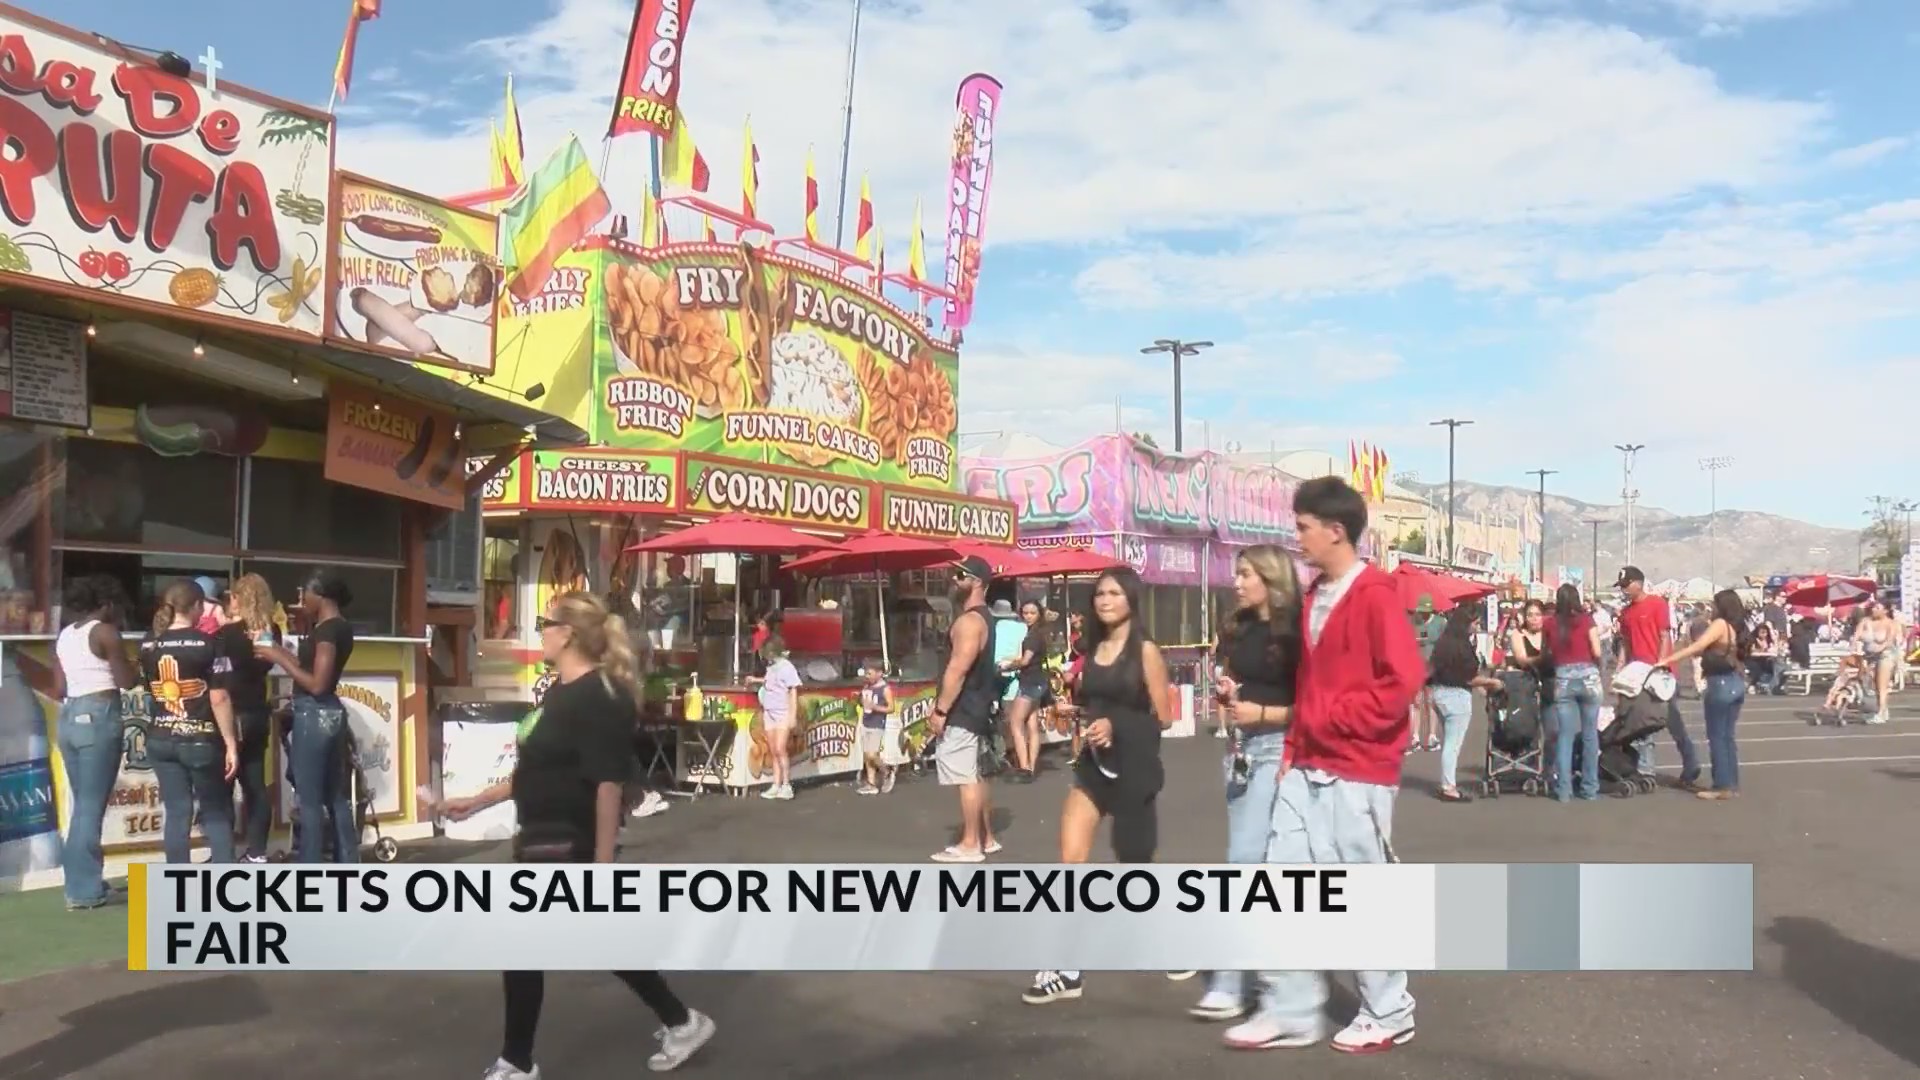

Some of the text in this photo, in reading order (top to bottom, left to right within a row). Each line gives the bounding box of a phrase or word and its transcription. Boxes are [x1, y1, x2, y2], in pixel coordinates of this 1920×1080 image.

[111, 62, 241, 155] De
[619, 96, 674, 130] FRIES
[368, 194, 394, 213] LONG
[395, 199, 421, 218] CORN
[415, 246, 440, 268] FRIED
[441, 246, 460, 262] MAC
[676, 267, 917, 364] FRY FACTORY
[609, 380, 694, 419] RIBBON
[343, 400, 417, 443] FROZEN
[618, 405, 682, 435] FRIES
[727, 414, 880, 464] FUNNEL CAKES
[907, 438, 951, 460] CURLY
[561, 458, 648, 473] CHEESY
[909, 458, 948, 481] FRIES
[539, 470, 669, 503] BACON FRIES
[707, 470, 861, 519] CORN DOGS
[888, 496, 1010, 537] FUNNEL CAKES
[820, 699, 844, 716] FRESH
[807, 723, 855, 746] RIBBON
[813, 741, 849, 760] FRIES
[125, 814, 162, 834] ICE
